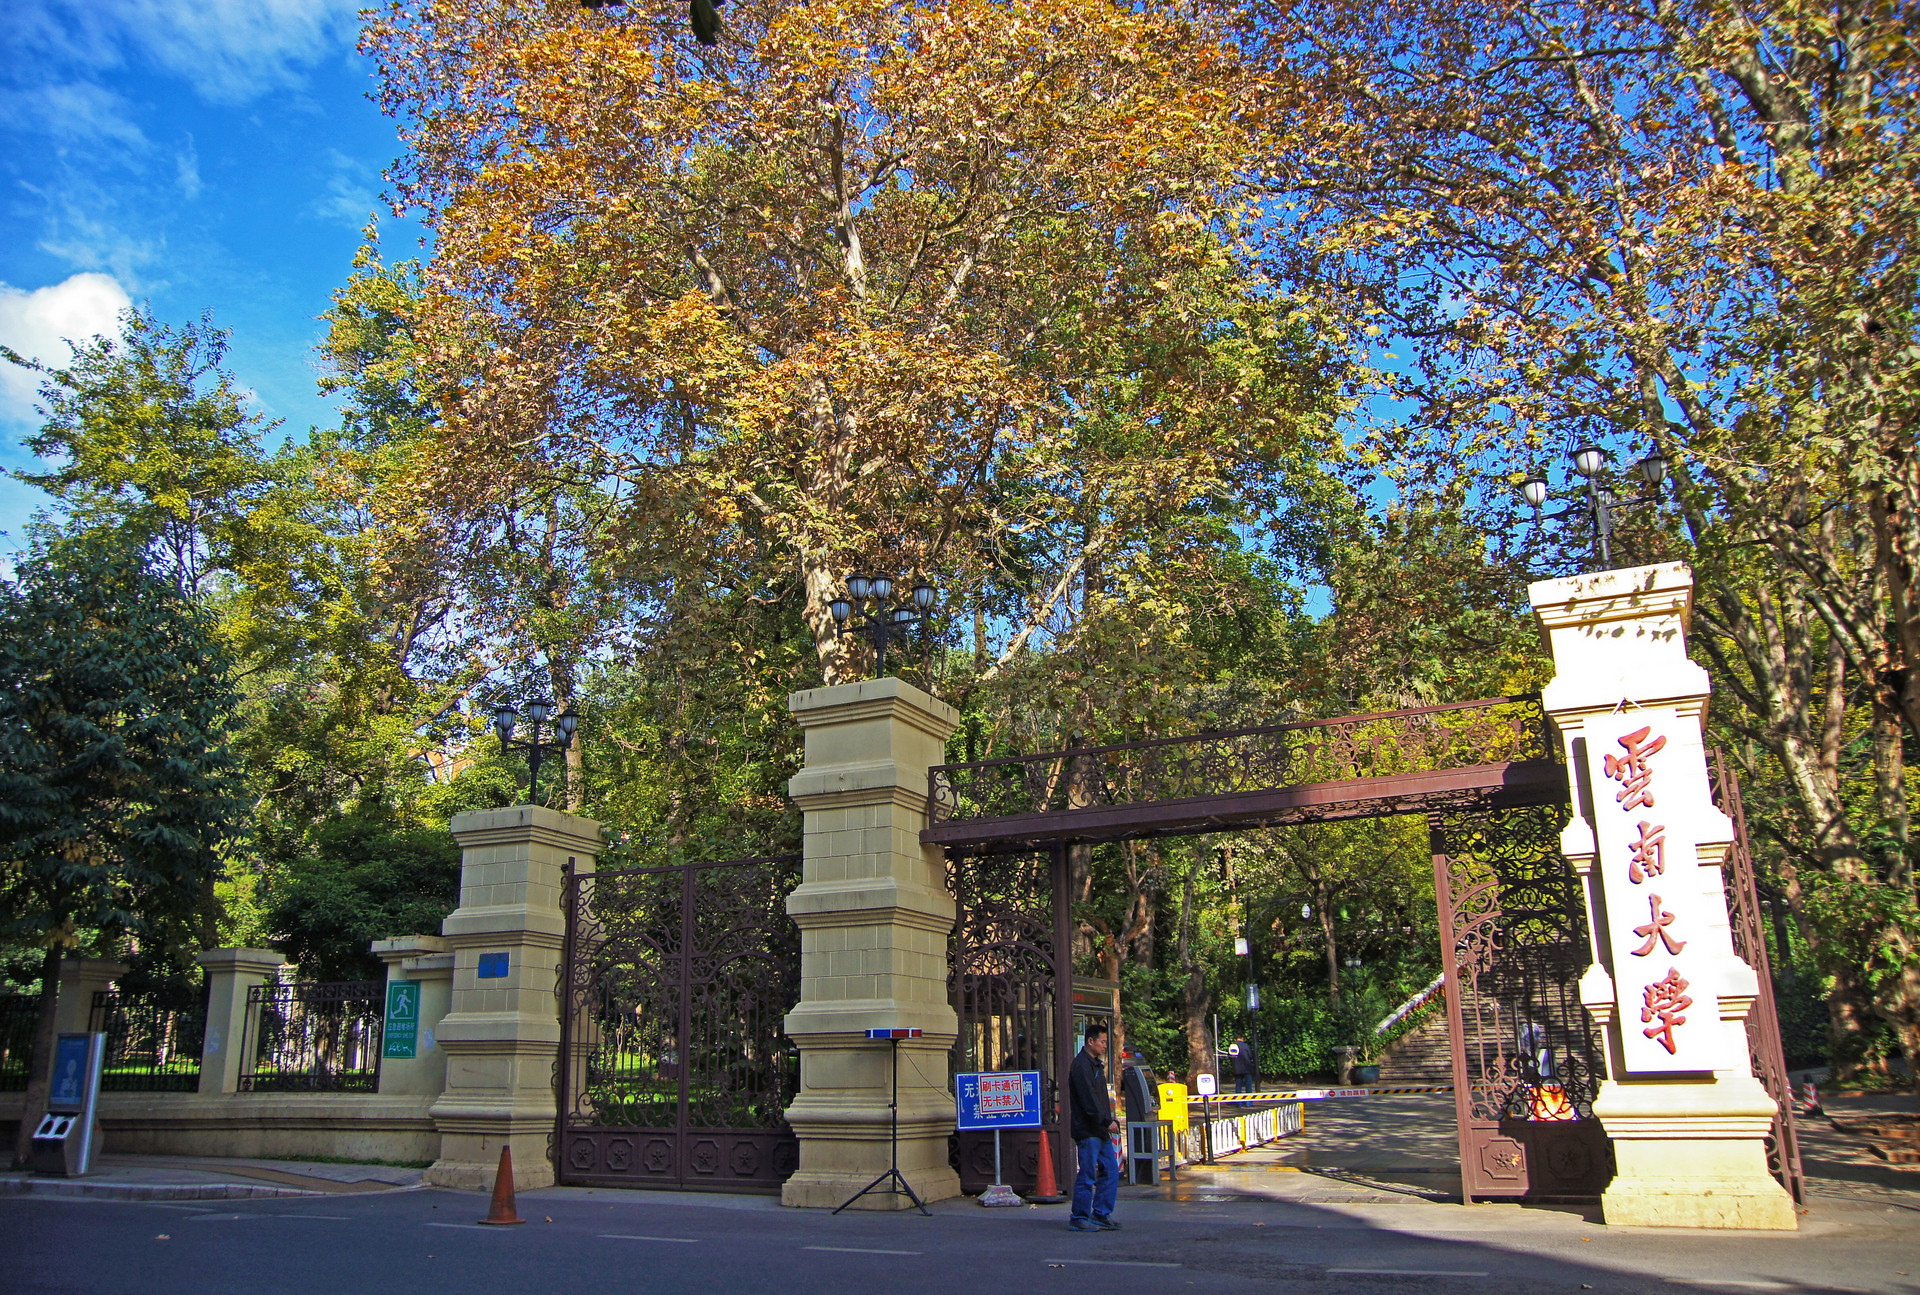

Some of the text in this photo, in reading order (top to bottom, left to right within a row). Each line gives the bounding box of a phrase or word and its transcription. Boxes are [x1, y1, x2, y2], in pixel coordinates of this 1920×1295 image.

[1604, 725, 1693, 1055] 雲南大學
[982, 1079, 1020, 1092] 刷卡通行
[984, 1095, 1021, 1107] 无卡禁入
